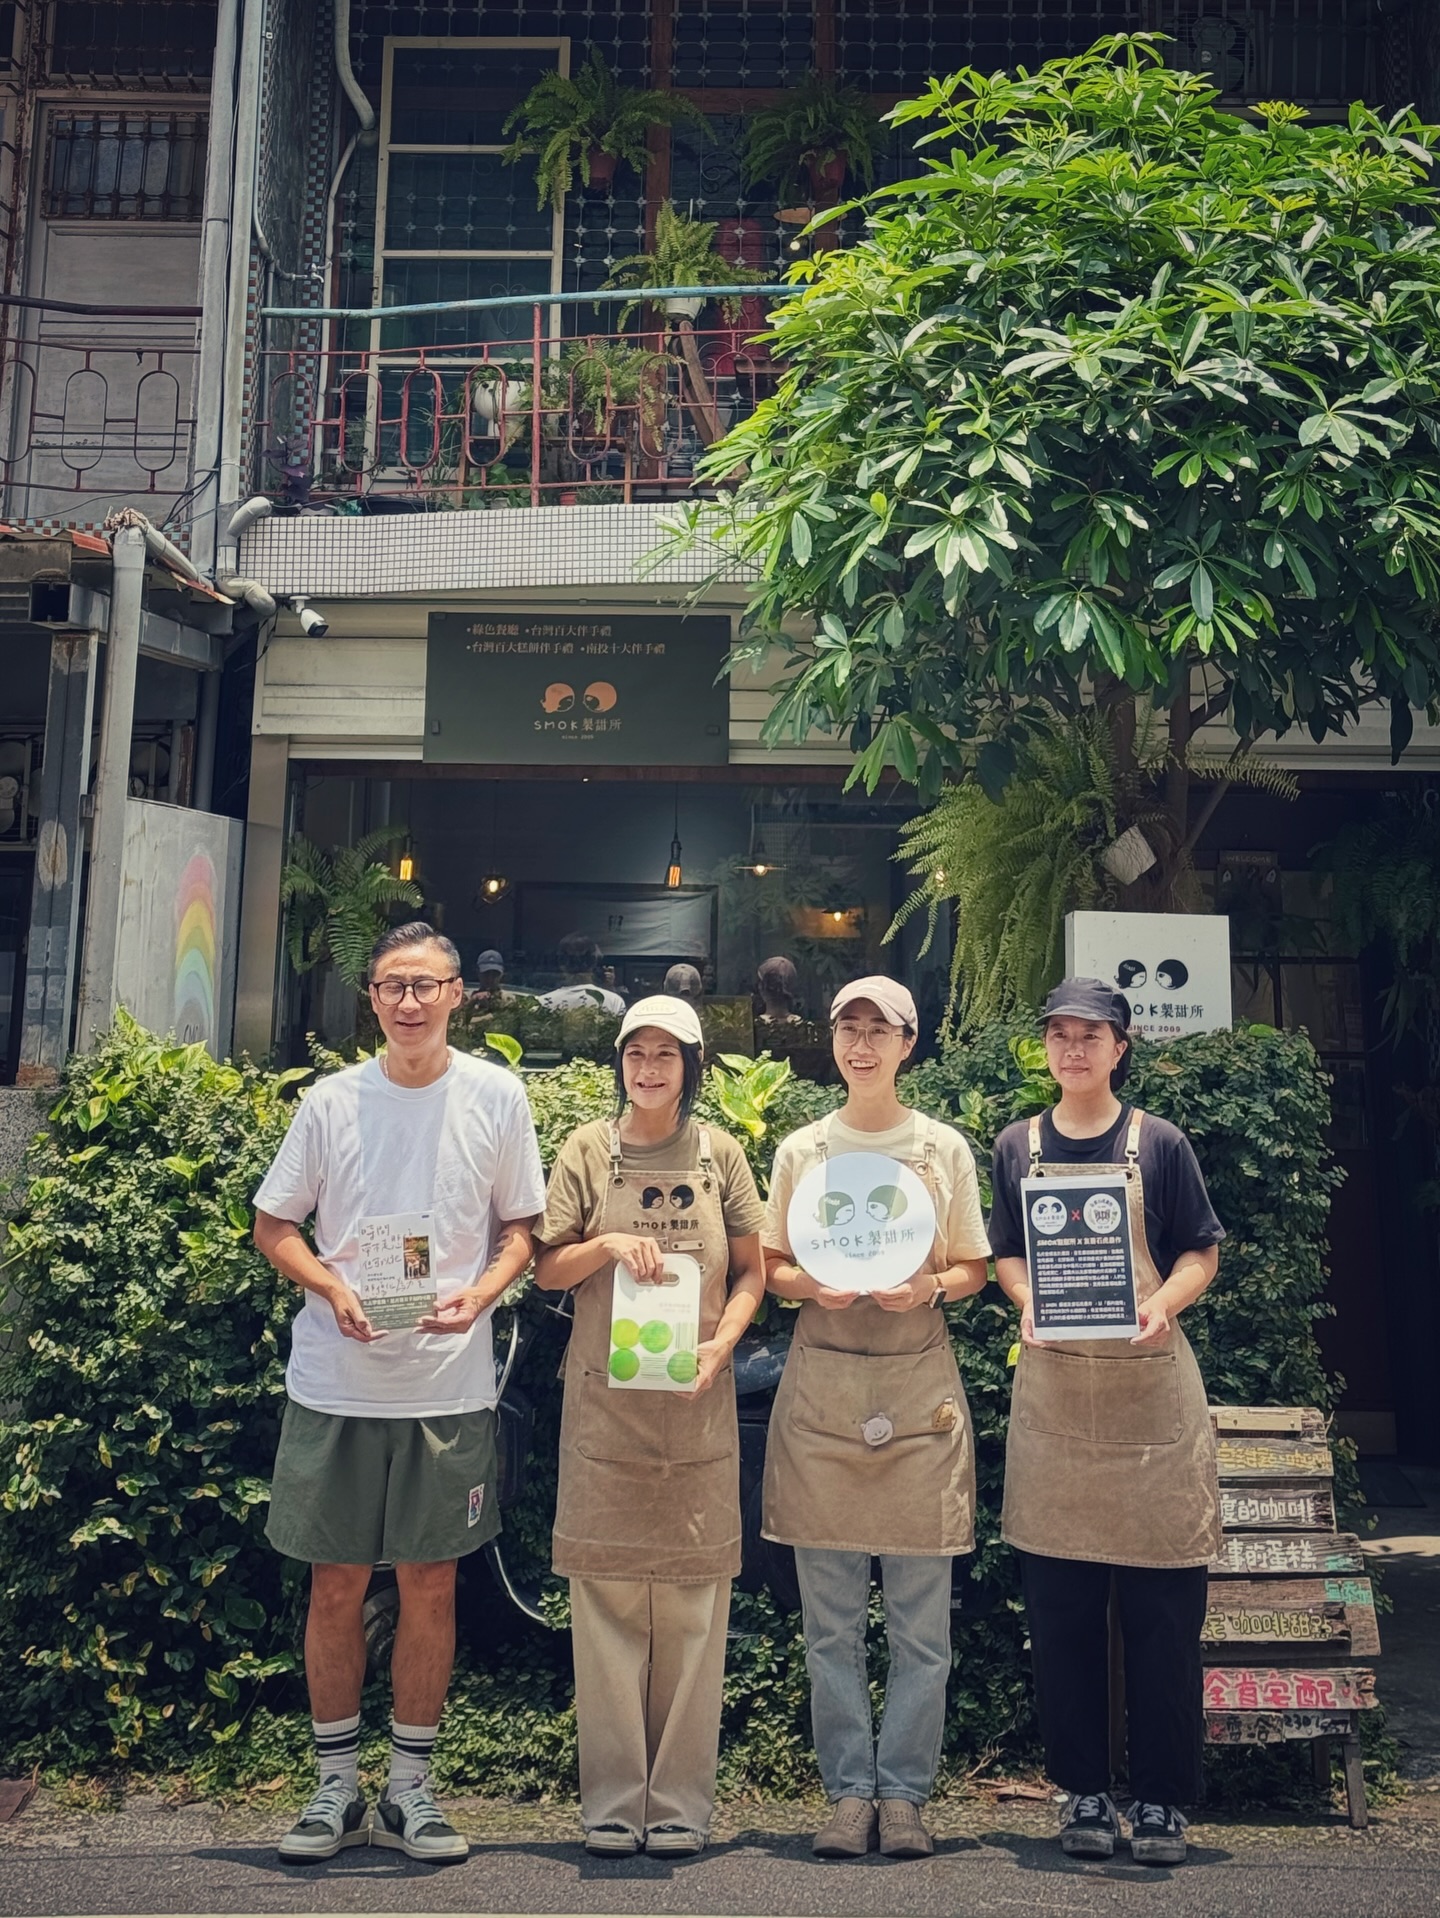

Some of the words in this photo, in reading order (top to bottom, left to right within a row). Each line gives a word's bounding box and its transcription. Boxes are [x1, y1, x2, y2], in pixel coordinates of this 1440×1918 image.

[586, 643, 666, 655] 南投十大伴手禮
[1204, 1669, 1337, 1708] 全省宅配
